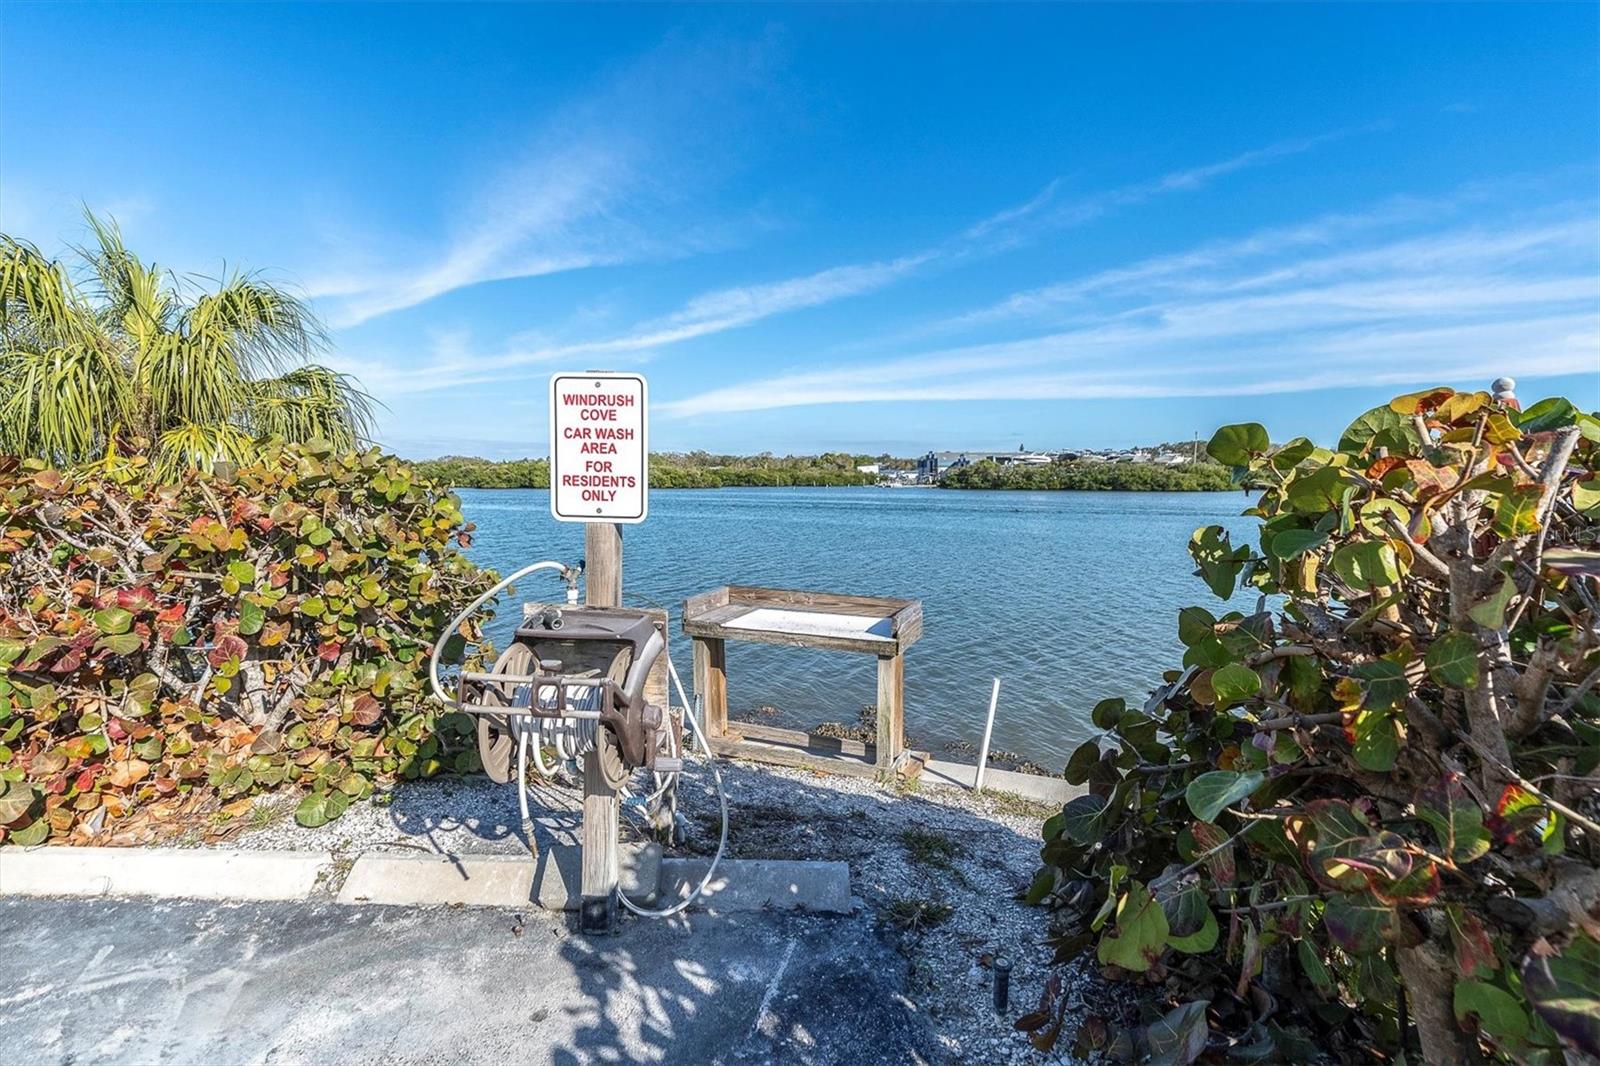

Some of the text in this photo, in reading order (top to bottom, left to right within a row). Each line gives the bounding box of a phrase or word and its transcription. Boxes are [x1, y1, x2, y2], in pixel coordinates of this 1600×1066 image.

[563, 394, 634, 407] WINDRUSH
[580, 409, 617, 421] COVE
[564, 427, 634, 440] CAR WASH
[580, 442, 617, 454] AREA
[585, 460, 612, 473] FOR
[562, 474, 636, 488] RESIDENTS
[581, 490, 617, 502] ONLY
